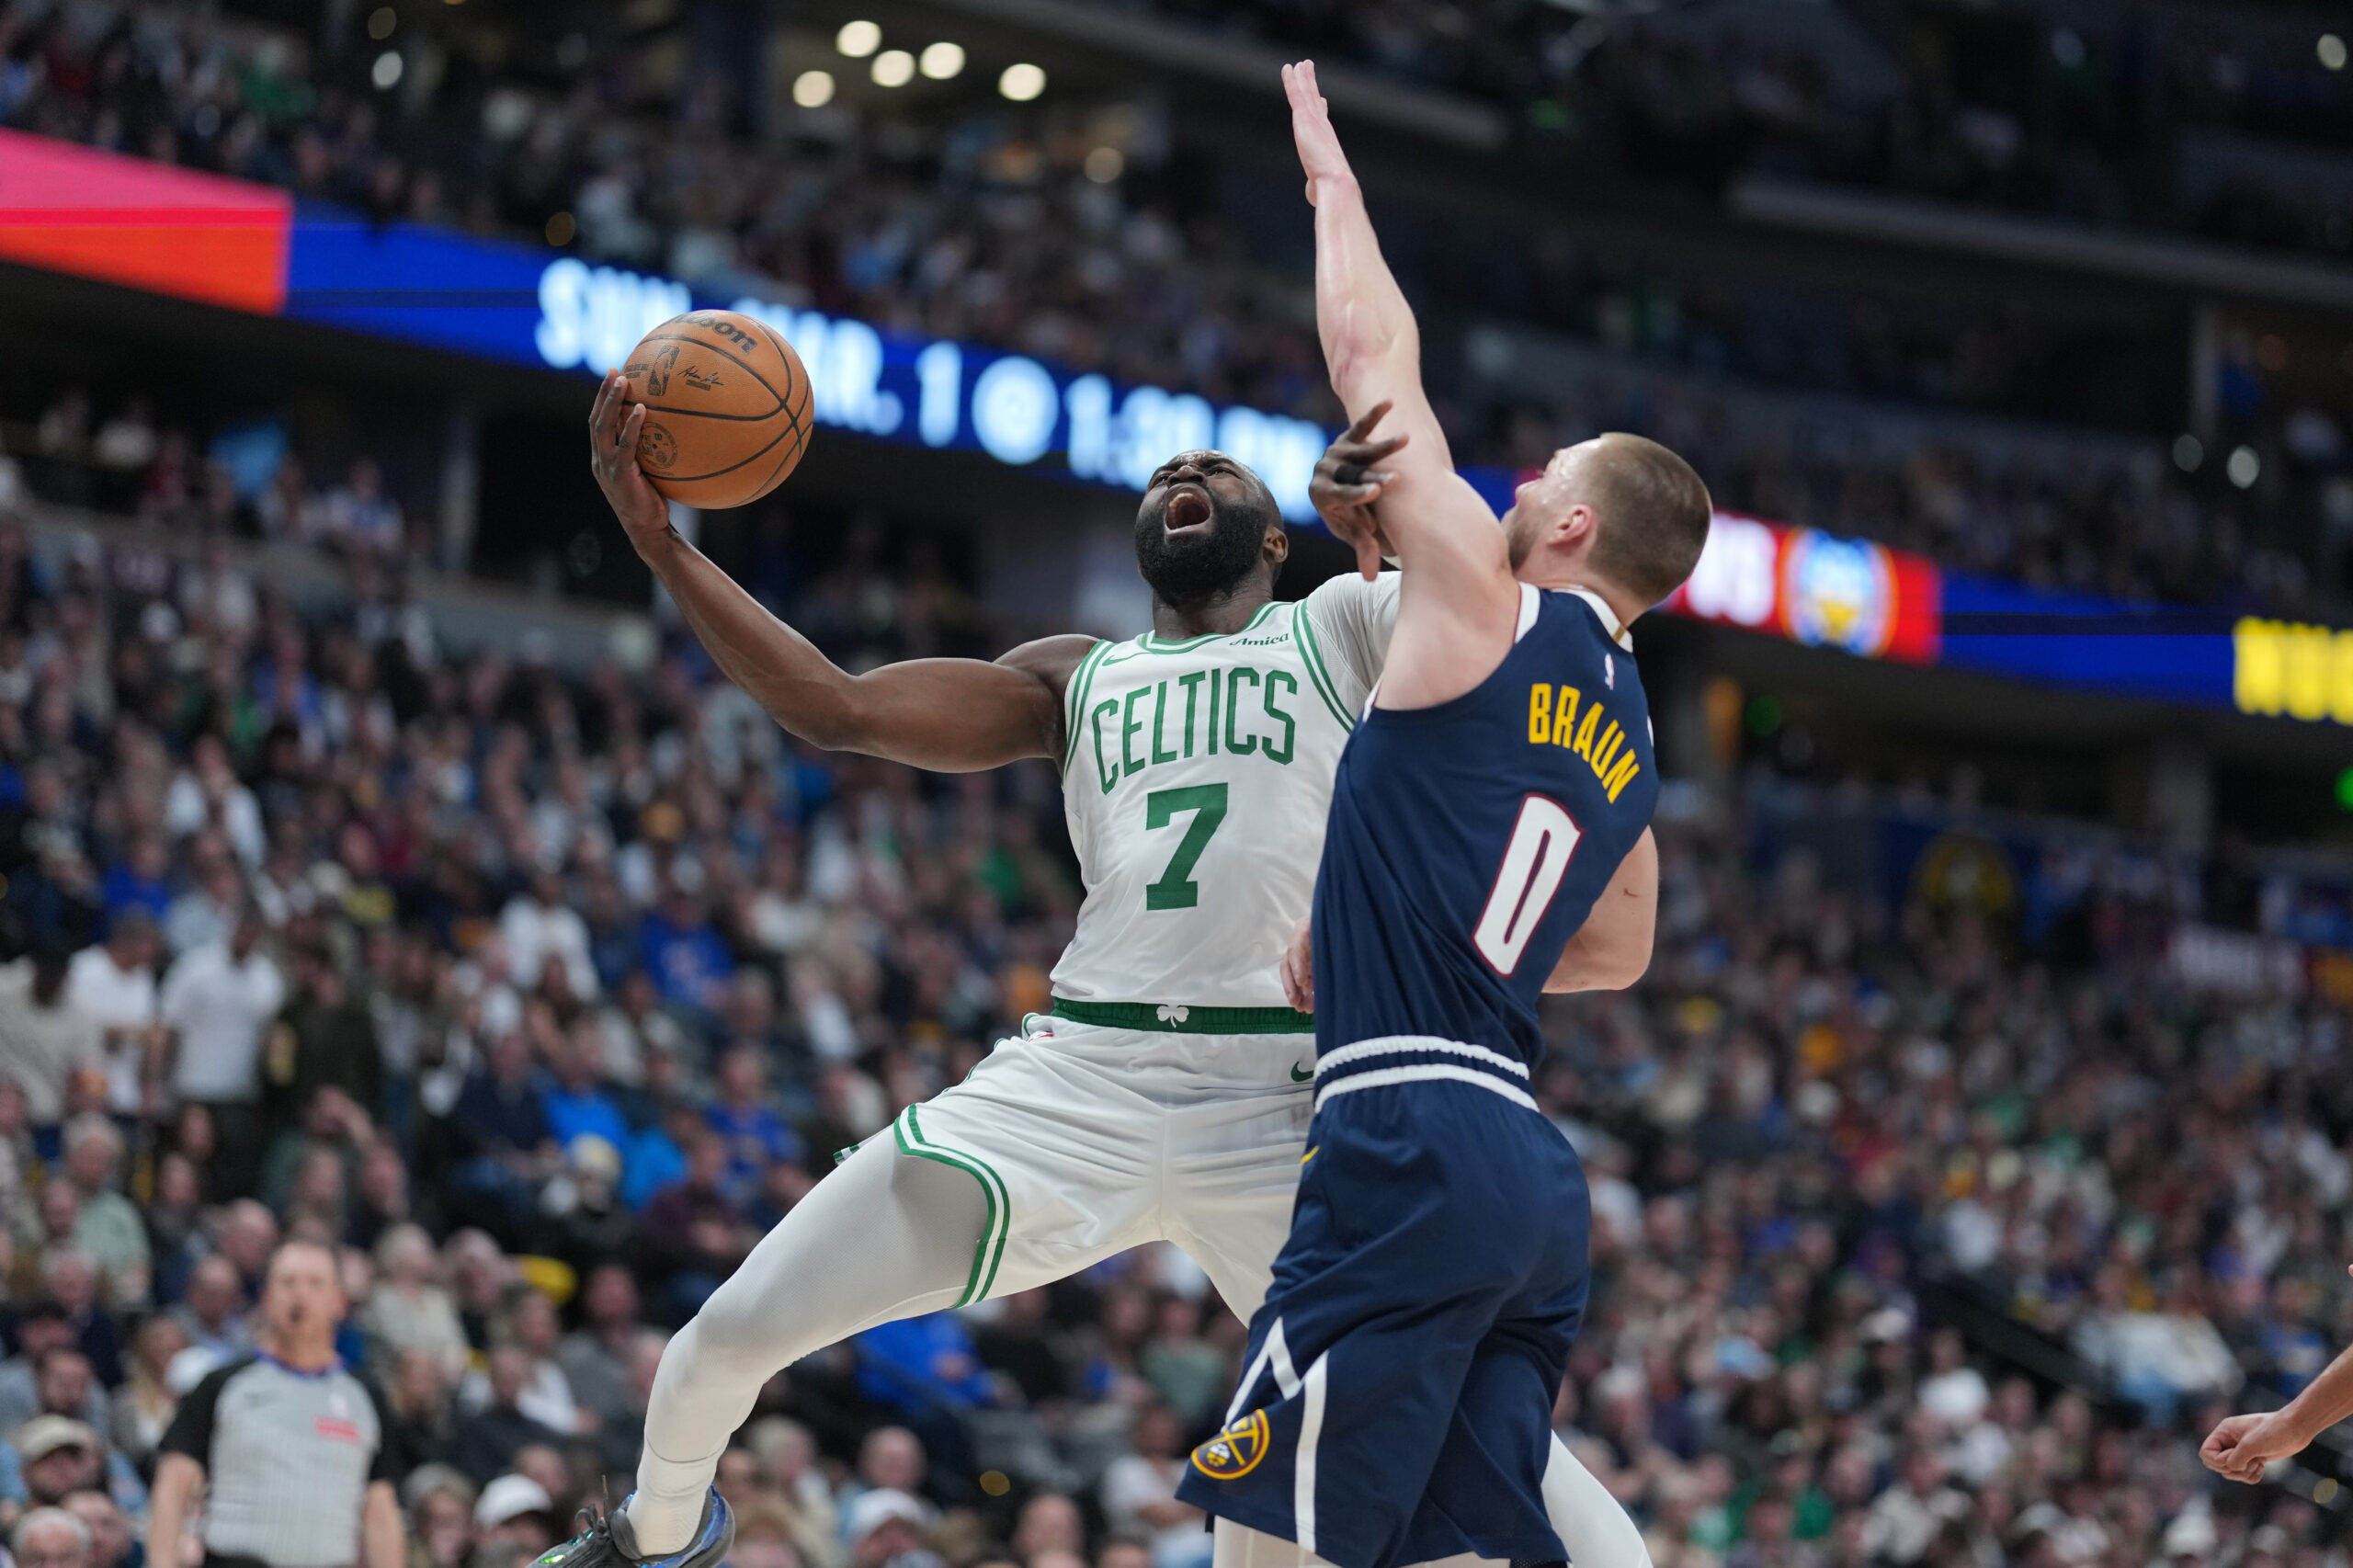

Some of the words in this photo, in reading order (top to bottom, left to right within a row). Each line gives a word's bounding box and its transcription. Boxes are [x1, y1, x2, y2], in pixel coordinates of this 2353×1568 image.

[1229, 632, 1289, 646] Amica
[1092, 666, 1298, 796] CELTICS
[1528, 683, 1640, 804] BRAUN
[1146, 782, 1229, 912] 7
[1472, 792, 1585, 977] 0
